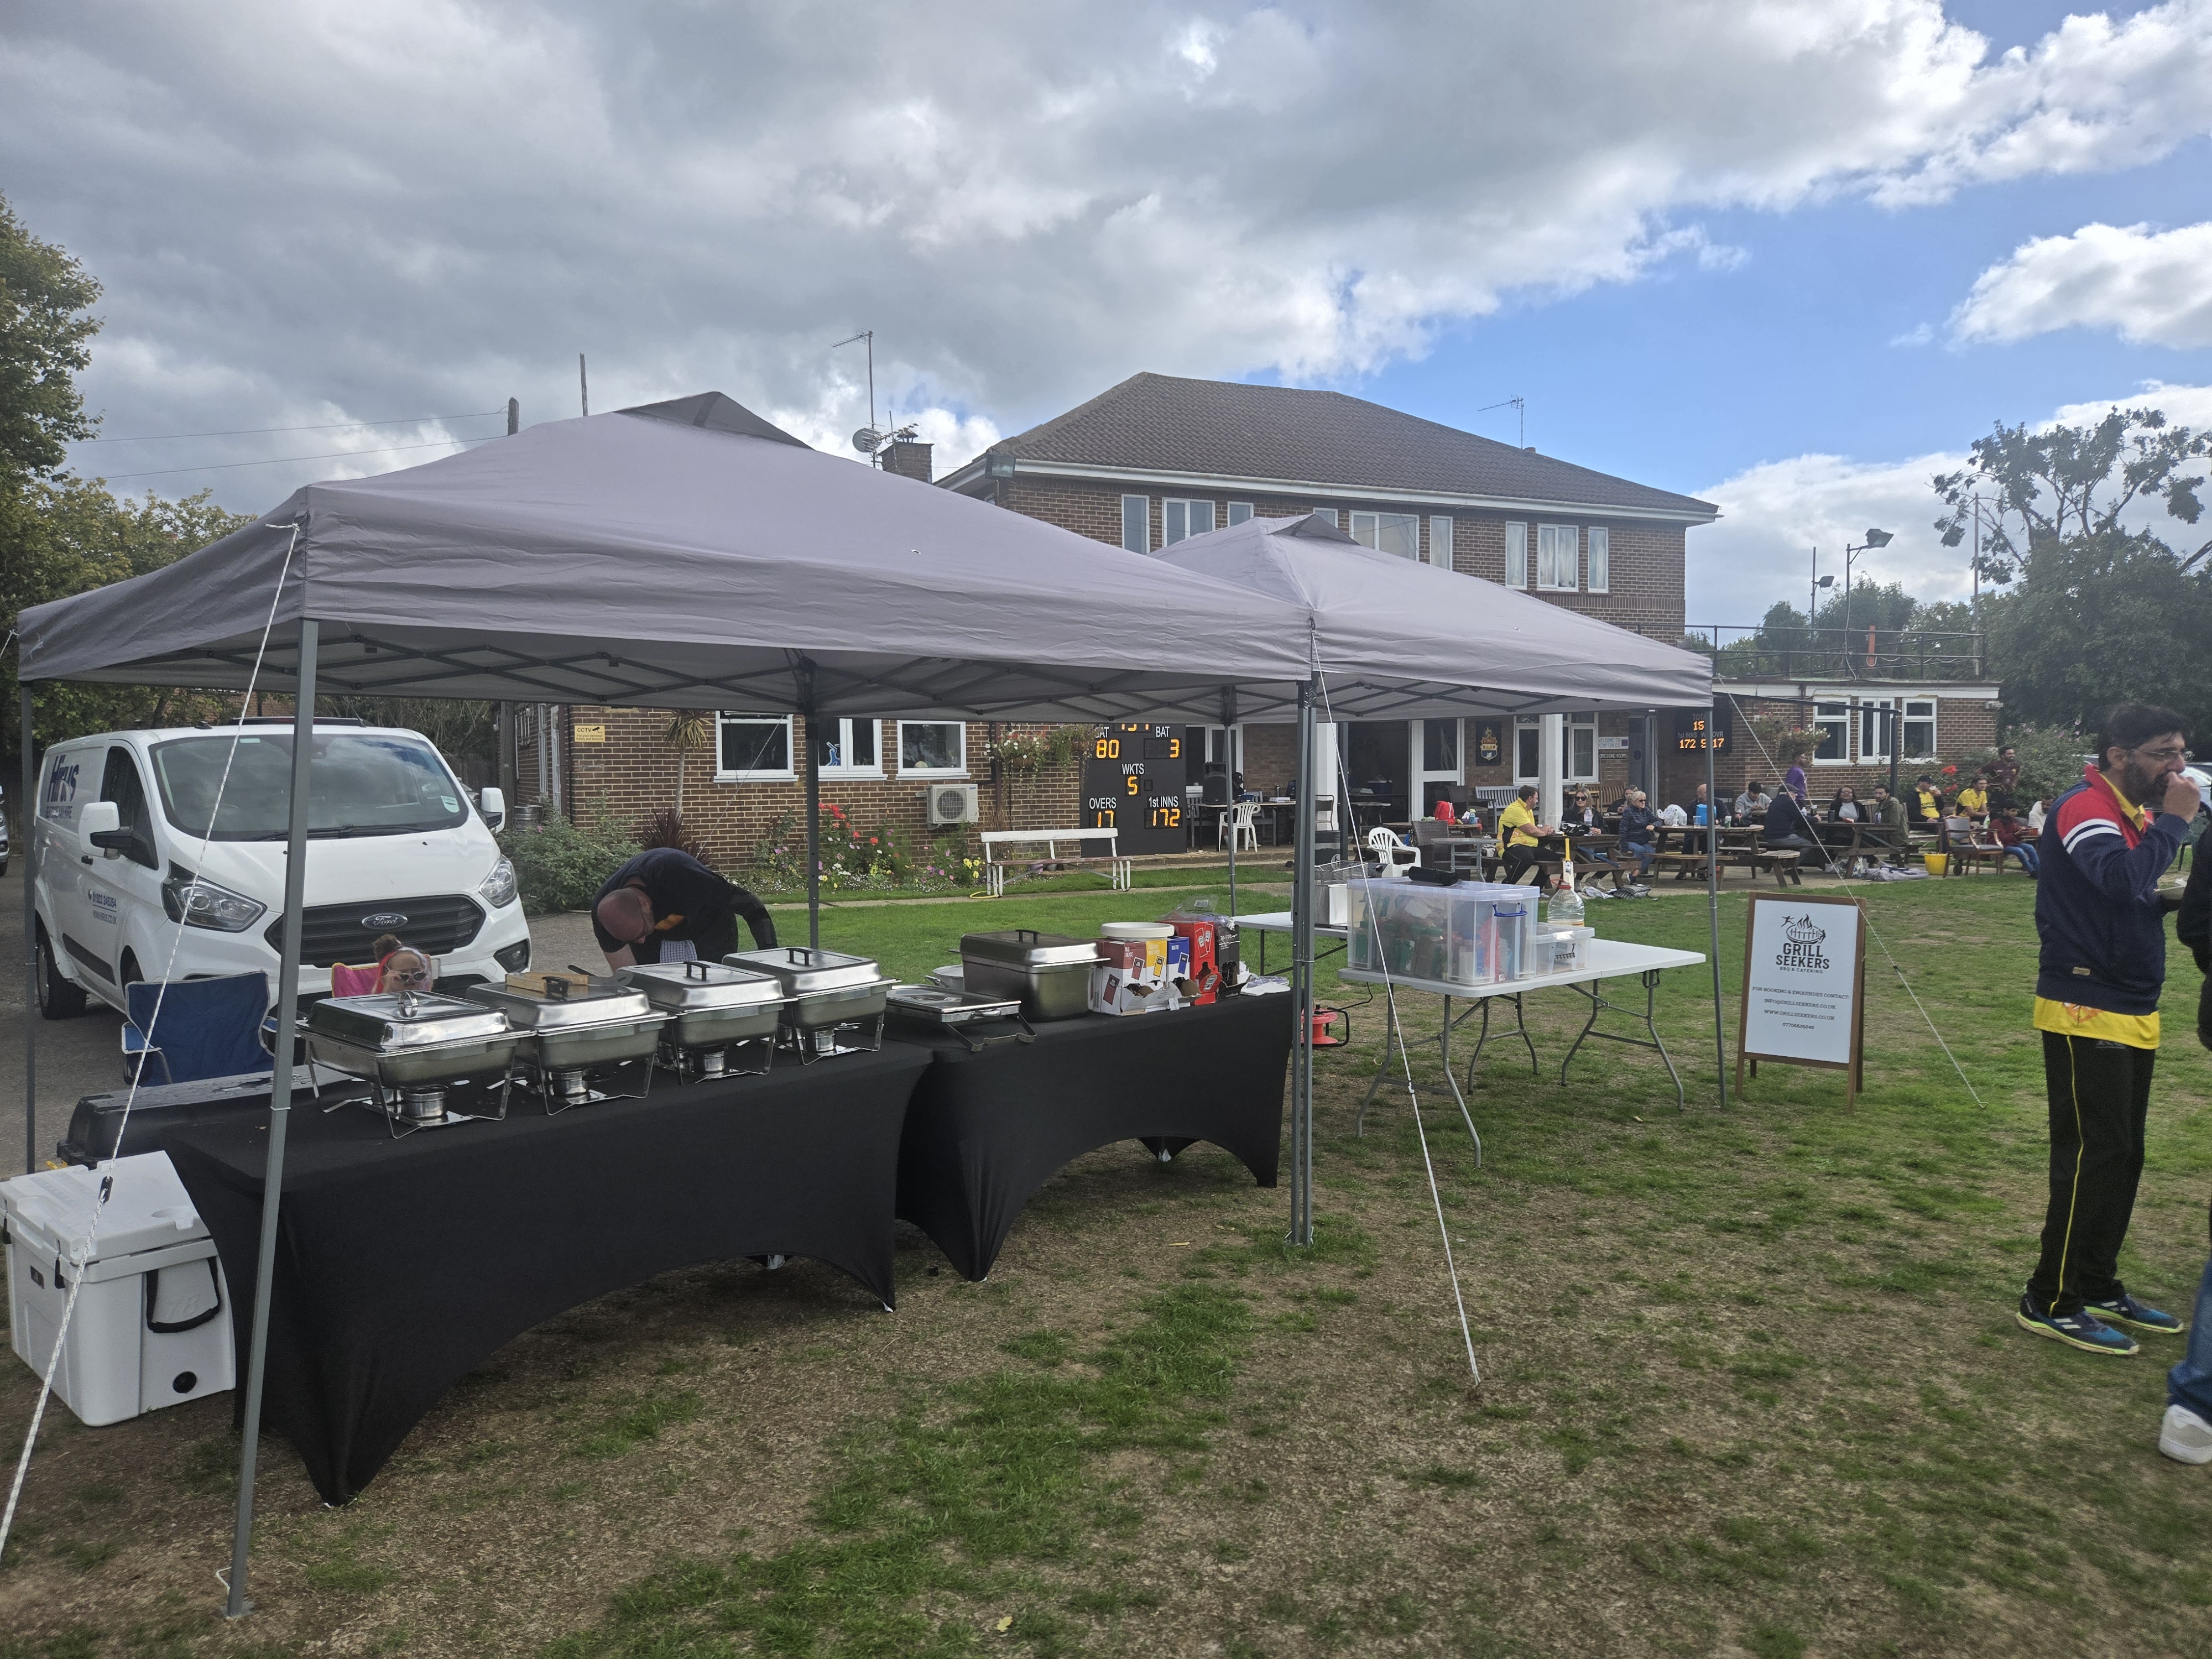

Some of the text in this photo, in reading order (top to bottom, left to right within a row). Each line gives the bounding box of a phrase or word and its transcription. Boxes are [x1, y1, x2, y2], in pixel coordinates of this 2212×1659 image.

[1156, 726, 1170, 737] BAT
[1693, 721, 1705, 731] 15
[1096, 739, 1119, 758] 80
[1170, 739, 1179, 758] 3
[1679, 739, 1696, 748] 172
[1713, 738, 1724, 748] 17
[1122, 763, 1144, 775] WKTS
[1128, 776, 1137, 795] 5
[1089, 797, 1117, 809] OVERS
[1149, 796, 1178, 808] 1st INNS
[1098, 810, 1114, 827] 17
[1152, 808, 1180, 827] 172
[373, 916, 398, 925] Ford
[1783, 943, 1823, 957] GRILL
[1776, 955, 1829, 969] SEEKERS
[1764, 999, 1835, 1009] INFO@GRILLSEEKERS.CO.UK
[1764, 1010, 1835, 1020] WWW.GRILLSEEKERS.CO.UK
